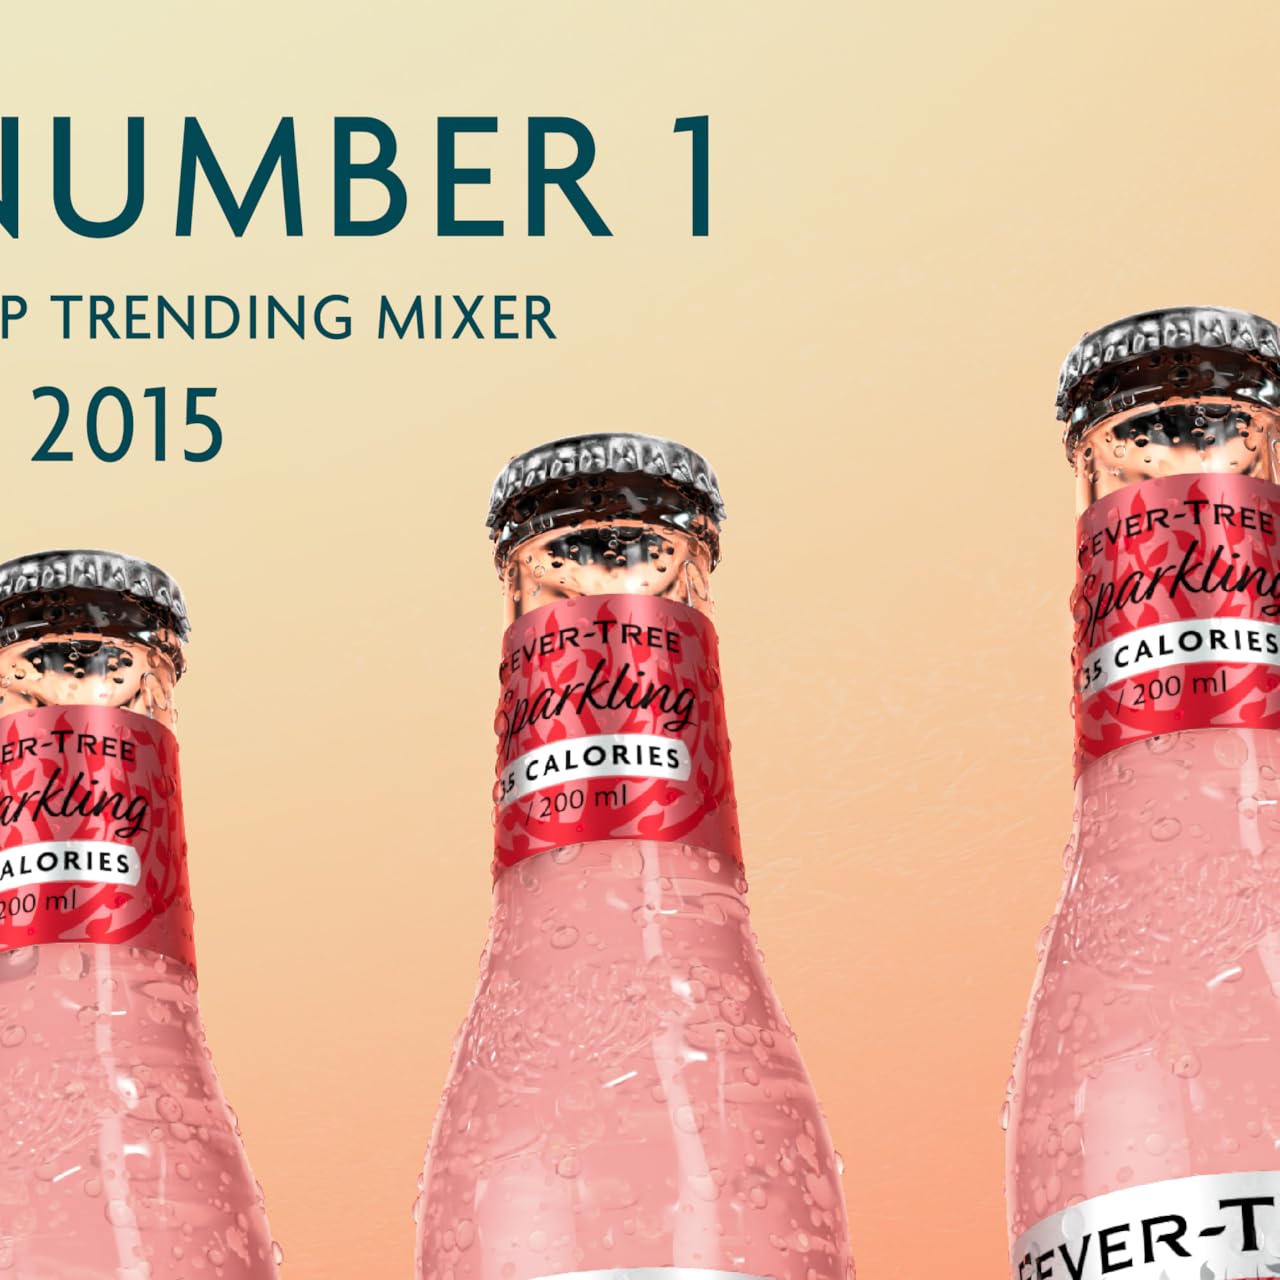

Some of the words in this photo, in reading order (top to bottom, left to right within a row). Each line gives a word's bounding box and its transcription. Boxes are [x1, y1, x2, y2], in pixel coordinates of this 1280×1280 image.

[1084, 659, 1103, 691] 35
[1115, 630, 1279, 668] CALORIES
[1133, 675, 1181, 705] 200
[1192, 670, 1226, 693] ml
[526, 744, 680, 781] CALORIES
[540, 789, 584, 818] 200
[595, 785, 627, 807] ml
[46, 889, 76, 910] ml
